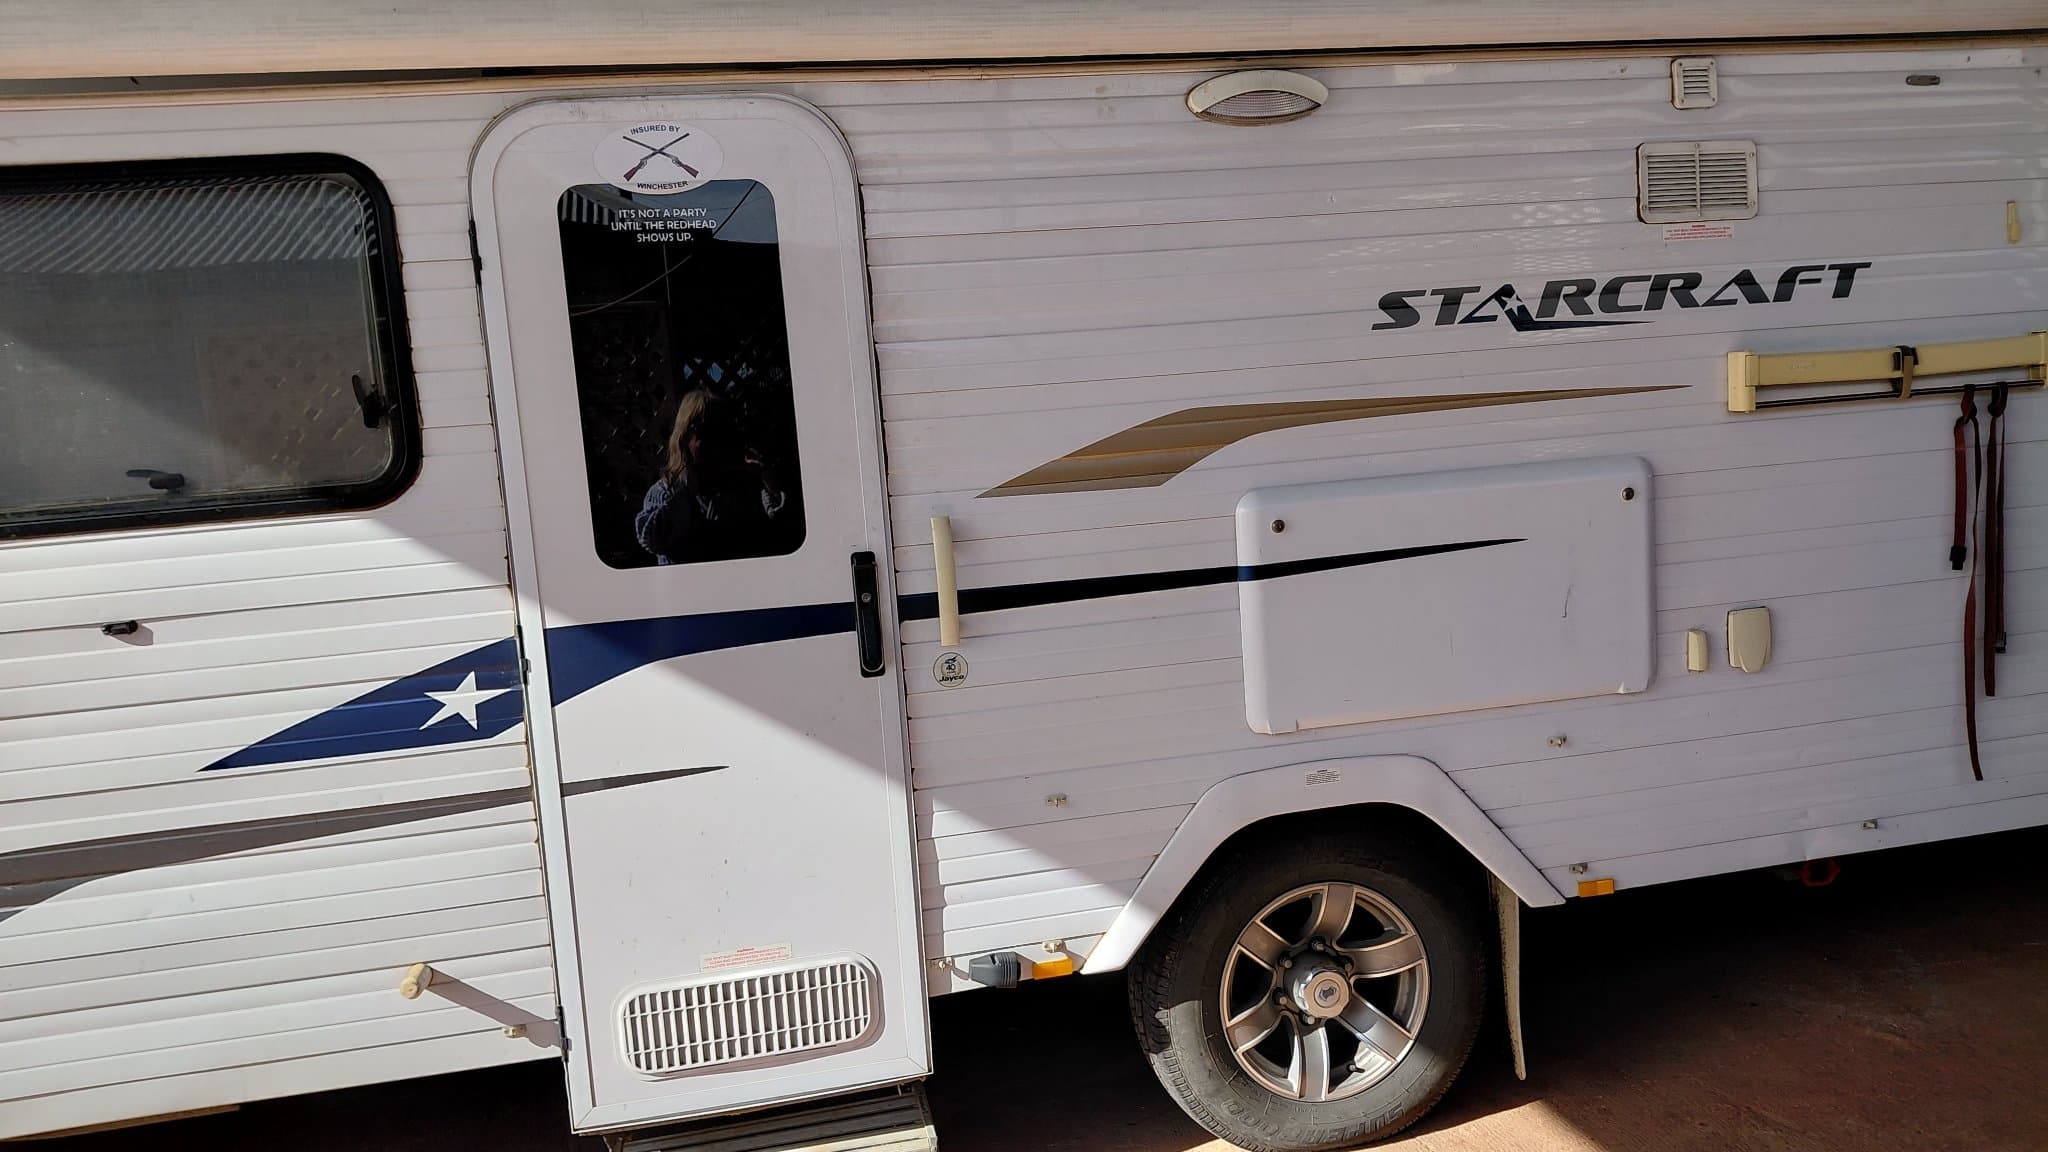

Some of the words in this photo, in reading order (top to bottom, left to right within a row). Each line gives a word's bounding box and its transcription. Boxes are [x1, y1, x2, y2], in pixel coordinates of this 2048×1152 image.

[630, 124, 667, 135] INSURED
[636, 180, 689, 190] WINCHESTER
[618, 209, 636, 219] IT'S
[638, 208, 661, 218] NOT
[663, 208, 672, 217] A
[673, 207, 708, 217] PARTY
[610, 221, 643, 231] UNTIL
[645, 221, 665, 230] THE
[667, 219, 717, 230] REDHEAD
[636, 232, 674, 243] SHOWS
[676, 232, 694, 241] UP.
[1371, 261, 1872, 332] STARCRAFT
[939, 674, 965, 682] Jayco
